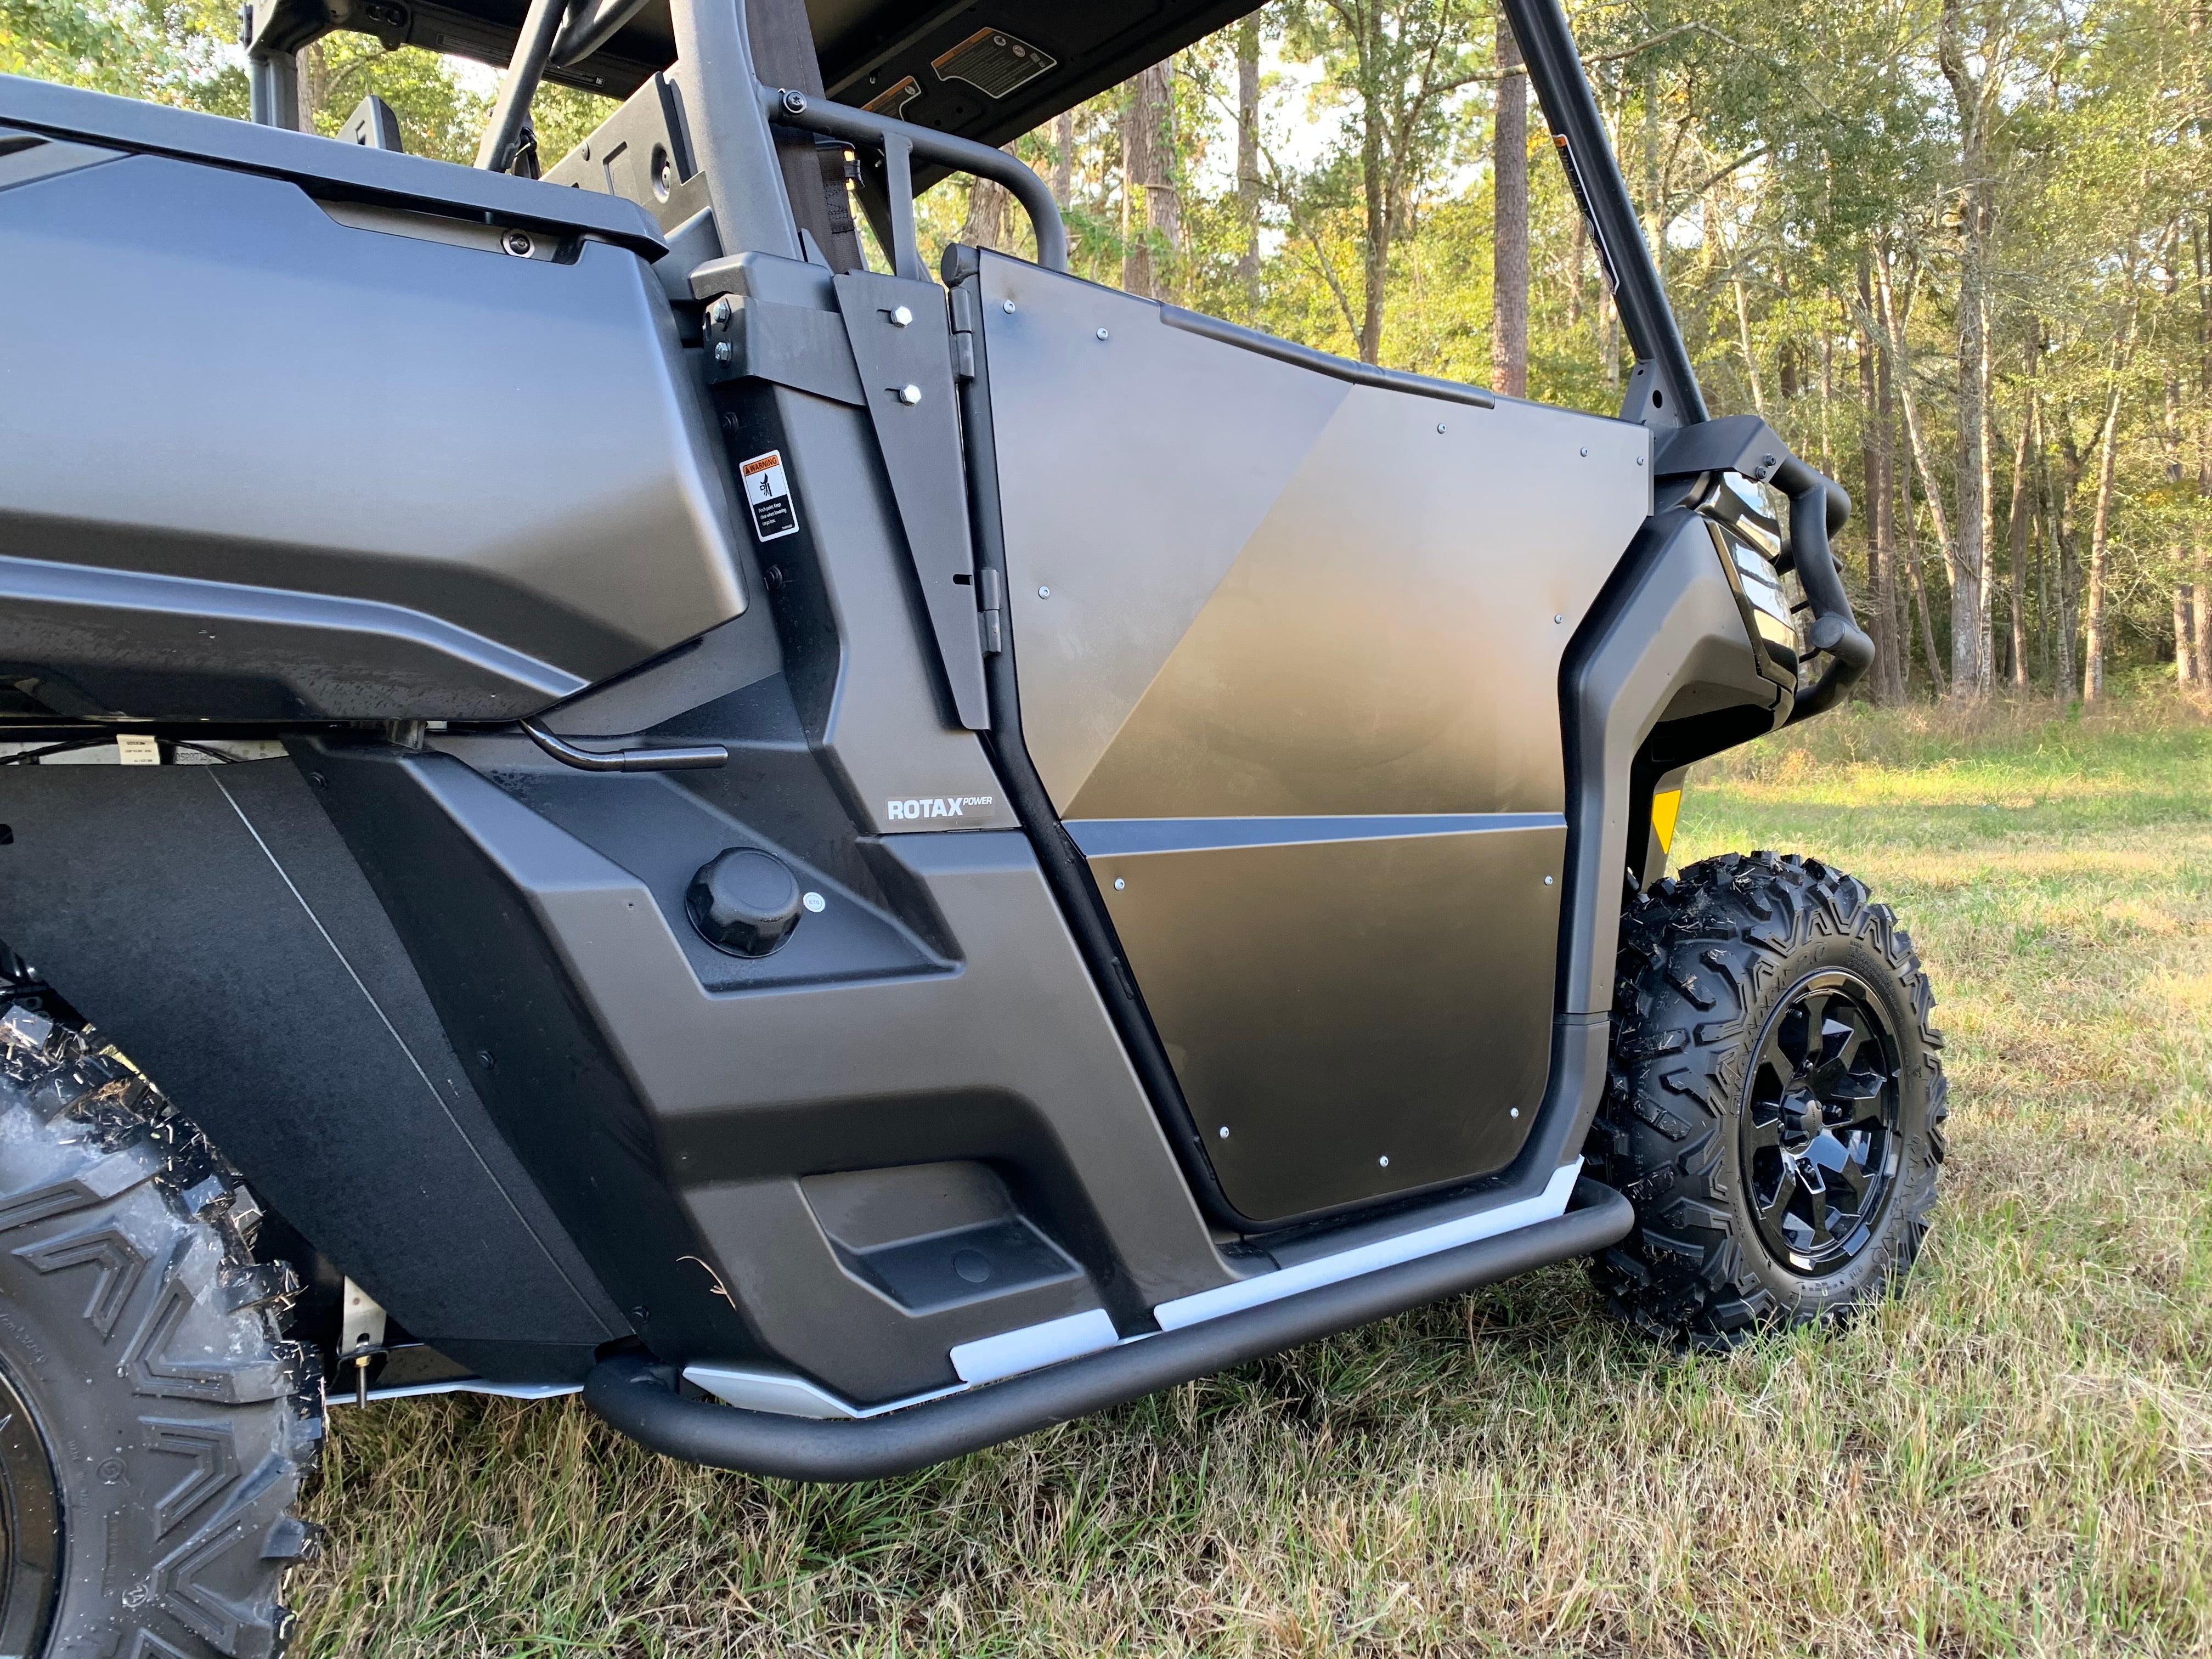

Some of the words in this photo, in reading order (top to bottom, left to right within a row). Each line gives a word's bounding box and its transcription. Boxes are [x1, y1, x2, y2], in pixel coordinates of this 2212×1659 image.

[749, 457, 777, 473] WARNING
[888, 798, 963, 820] ROTAX
[963, 796, 992, 805] POWER
